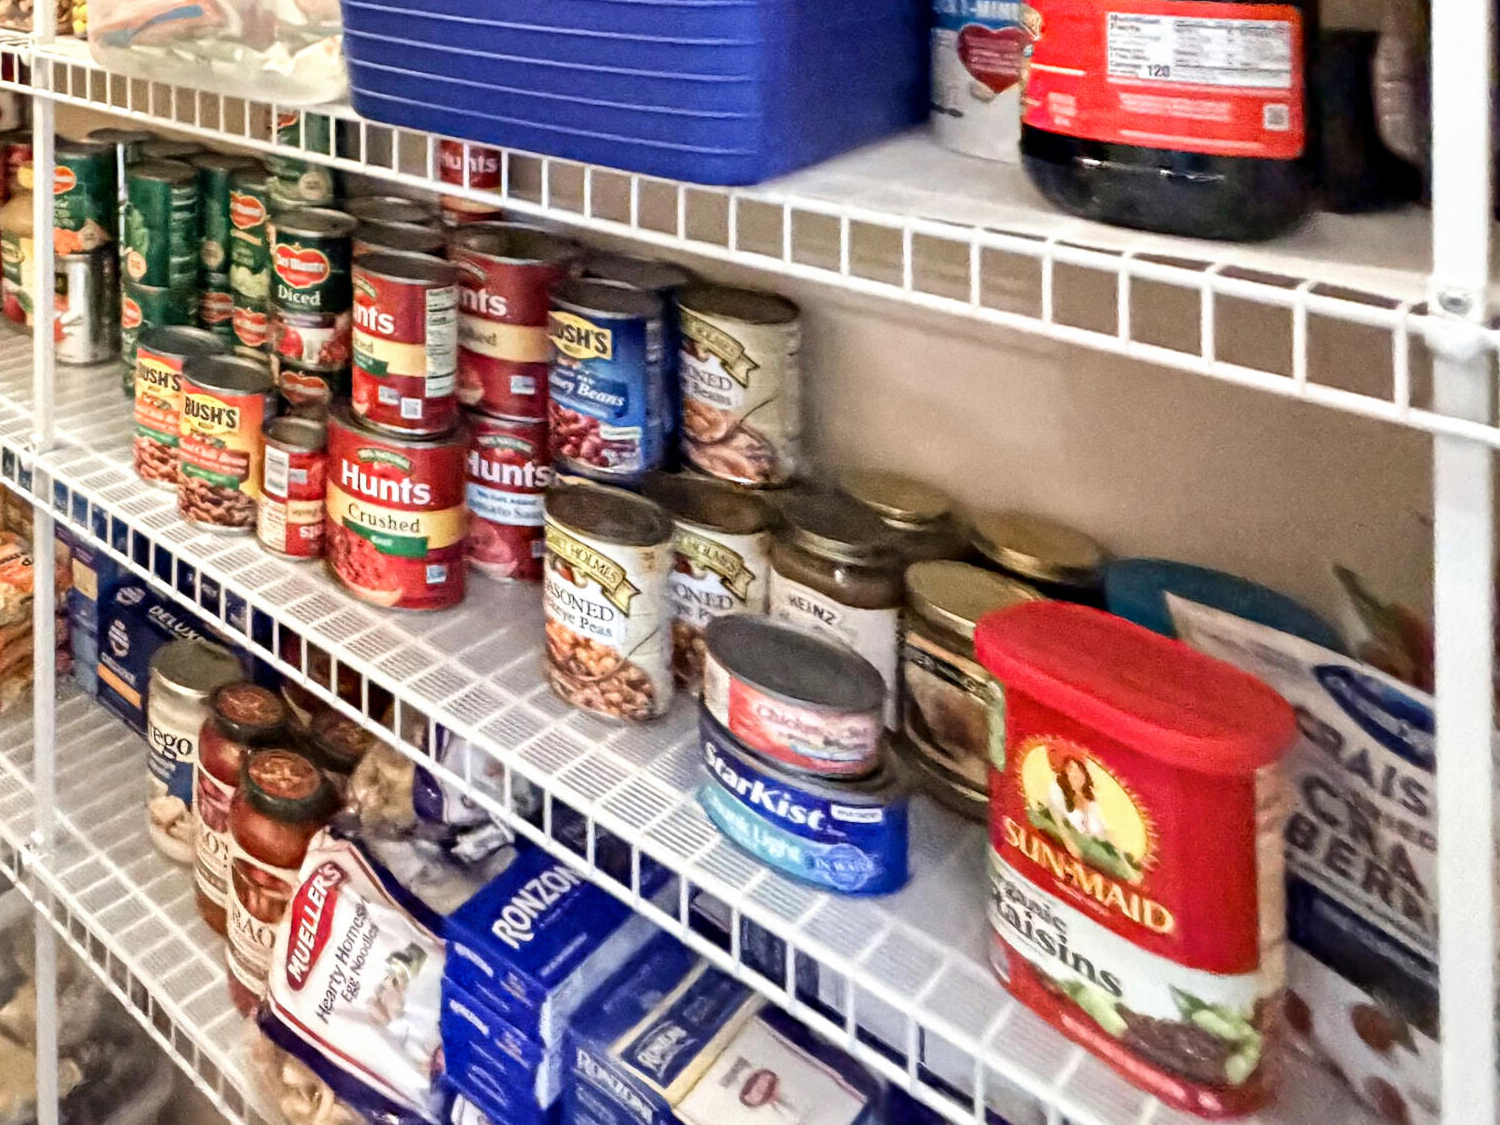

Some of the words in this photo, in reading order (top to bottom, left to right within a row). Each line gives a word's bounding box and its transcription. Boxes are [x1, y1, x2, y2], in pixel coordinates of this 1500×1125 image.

[278, 284, 322, 307] Diced
[555, 323, 609, 356] USH'S
[184, 394, 239, 430] BUSH'S
[577, 382, 626, 408] Beans
[341, 458, 432, 506] Hunts
[347, 502, 421, 534] Crushed
[549, 580, 615, 623] ASONED
[579, 613, 614, 639] Peas
[151, 726, 194, 760] rego
[704, 741, 826, 831] StarKist
[1001, 815, 1176, 935] SUN-MAID
[287, 862, 344, 983] MUELLER'S
[491, 864, 581, 951] RONZON
[315, 963, 348, 1025] Hearty
